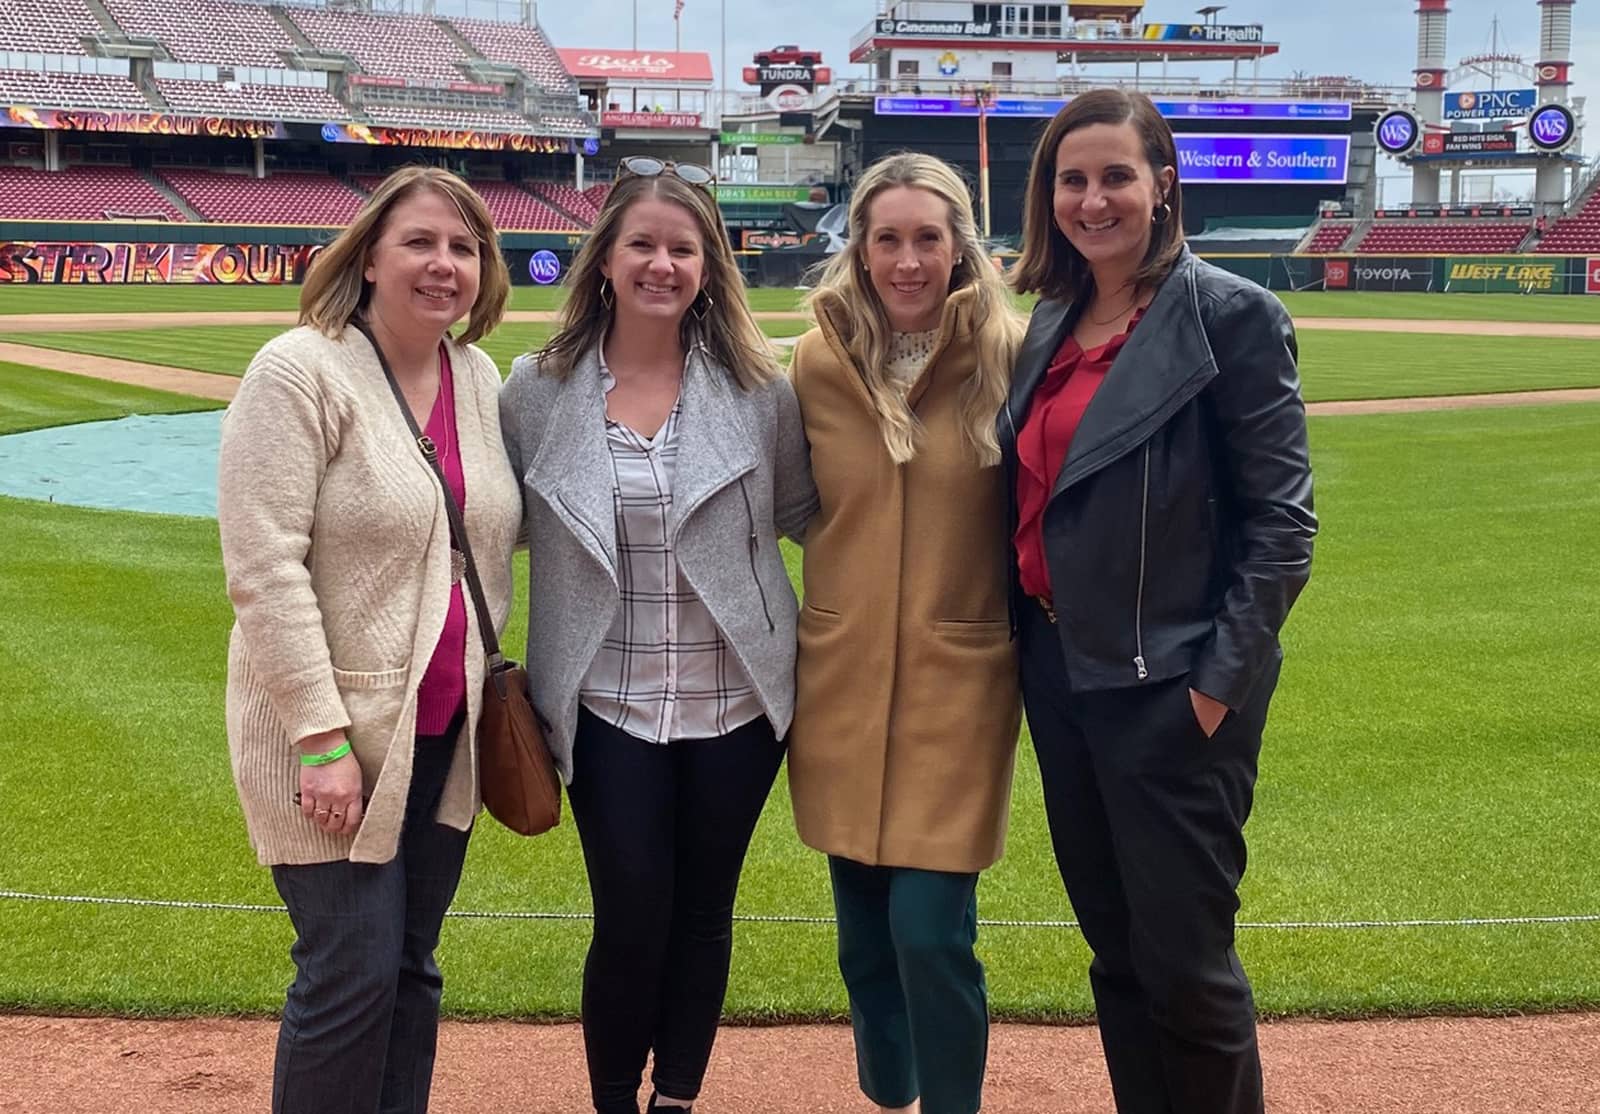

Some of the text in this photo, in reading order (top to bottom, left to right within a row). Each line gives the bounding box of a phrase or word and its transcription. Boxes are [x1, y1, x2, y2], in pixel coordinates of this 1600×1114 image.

[896, 22, 991, 34] Cincinnati Bell
[1204, 26, 1261, 41] TriHealth
[577, 54, 675, 70] Reds
[762, 69, 811, 80] TUNDRA
[1478, 92, 1520, 108] PNC
[1446, 107, 1530, 119] POWER STACKS
[56, 111, 154, 134] STRIKE
[155, 114, 203, 136] OUT
[670, 116, 697, 127] PATIO
[385, 129, 466, 148] STRIKE
[464, 130, 511, 150] OUT
[1462, 142, 1482, 150] WINS
[1179, 150, 1337, 169] Western & Southern
[0, 243, 199, 284] STRIKE
[210, 244, 301, 284] OUT
[1354, 268, 1411, 280] TOYOTA
[1450, 264, 1554, 280] WEST LAKE
